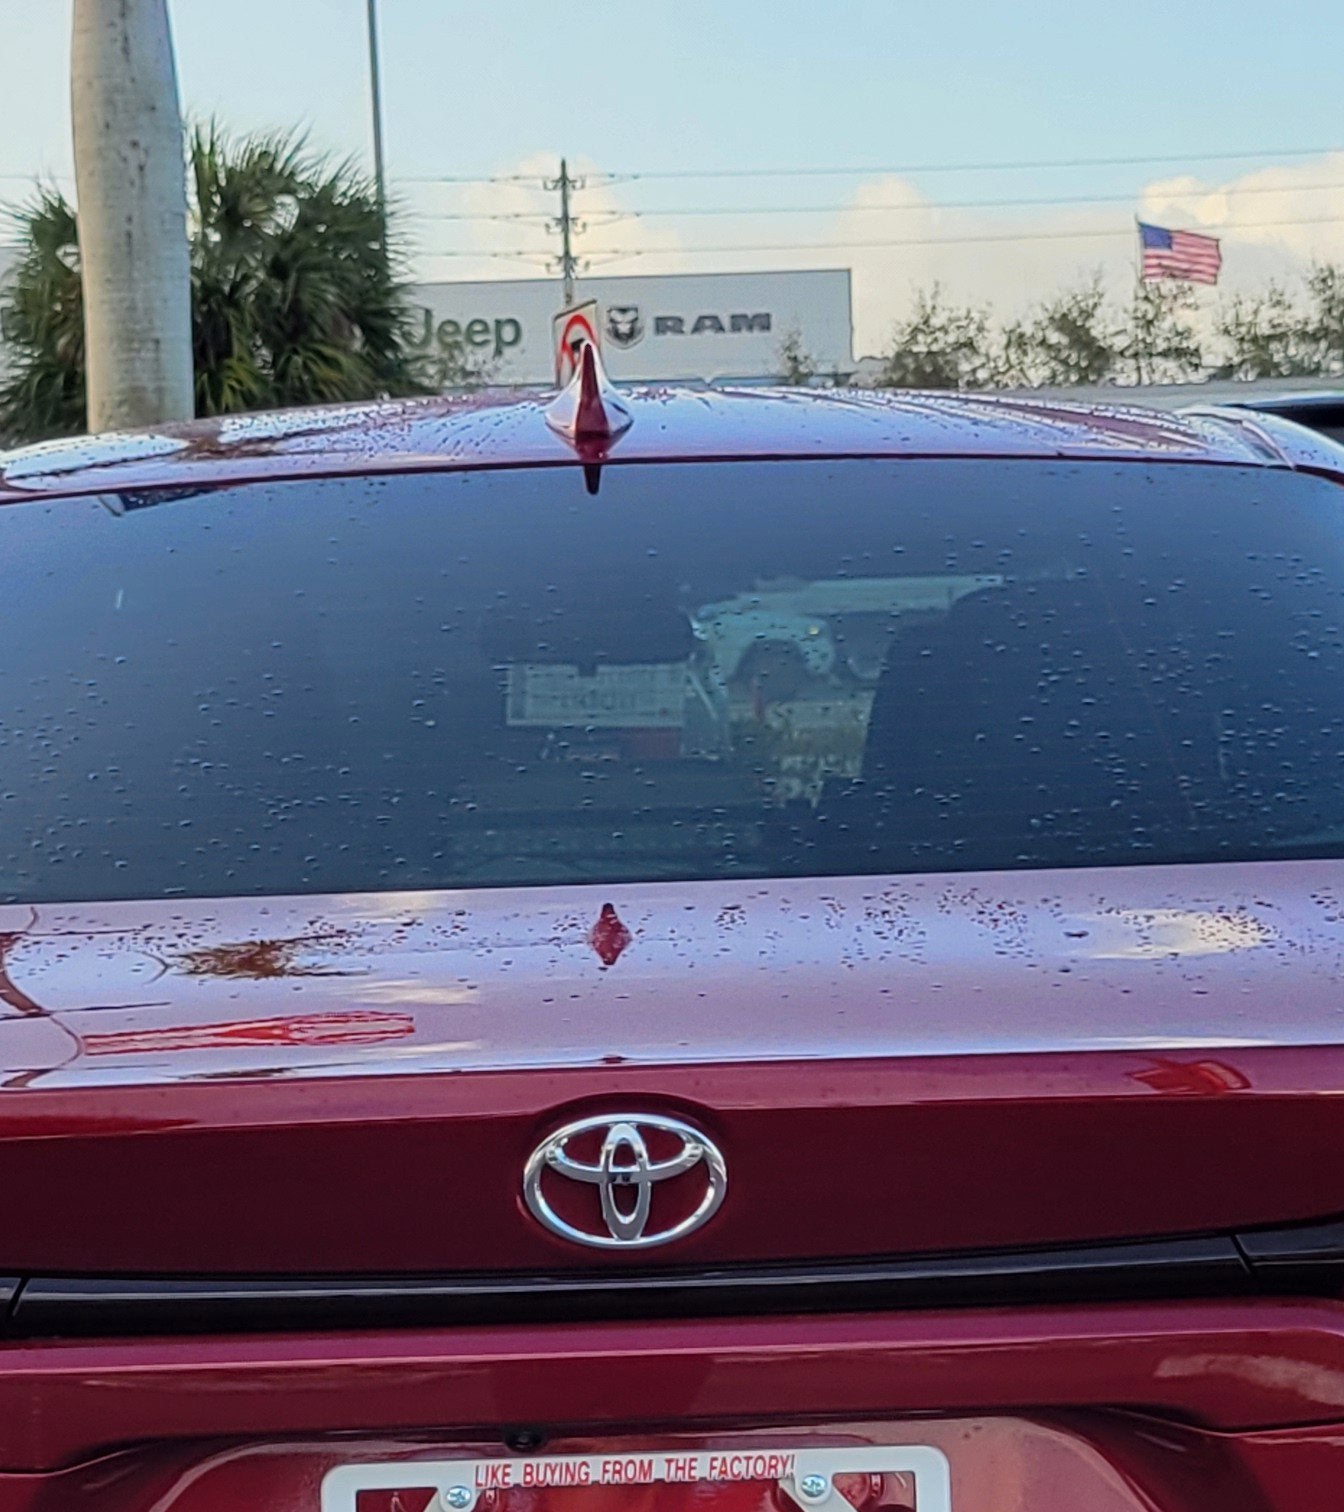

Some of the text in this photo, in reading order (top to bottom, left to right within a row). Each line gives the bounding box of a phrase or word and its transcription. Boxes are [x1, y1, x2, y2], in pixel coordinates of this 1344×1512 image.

[401, 308, 522, 359] Jeep
[654, 312, 772, 336] RAM
[475, 1454, 796, 1488] LIKE BUYING FROM THE FACTORY!
